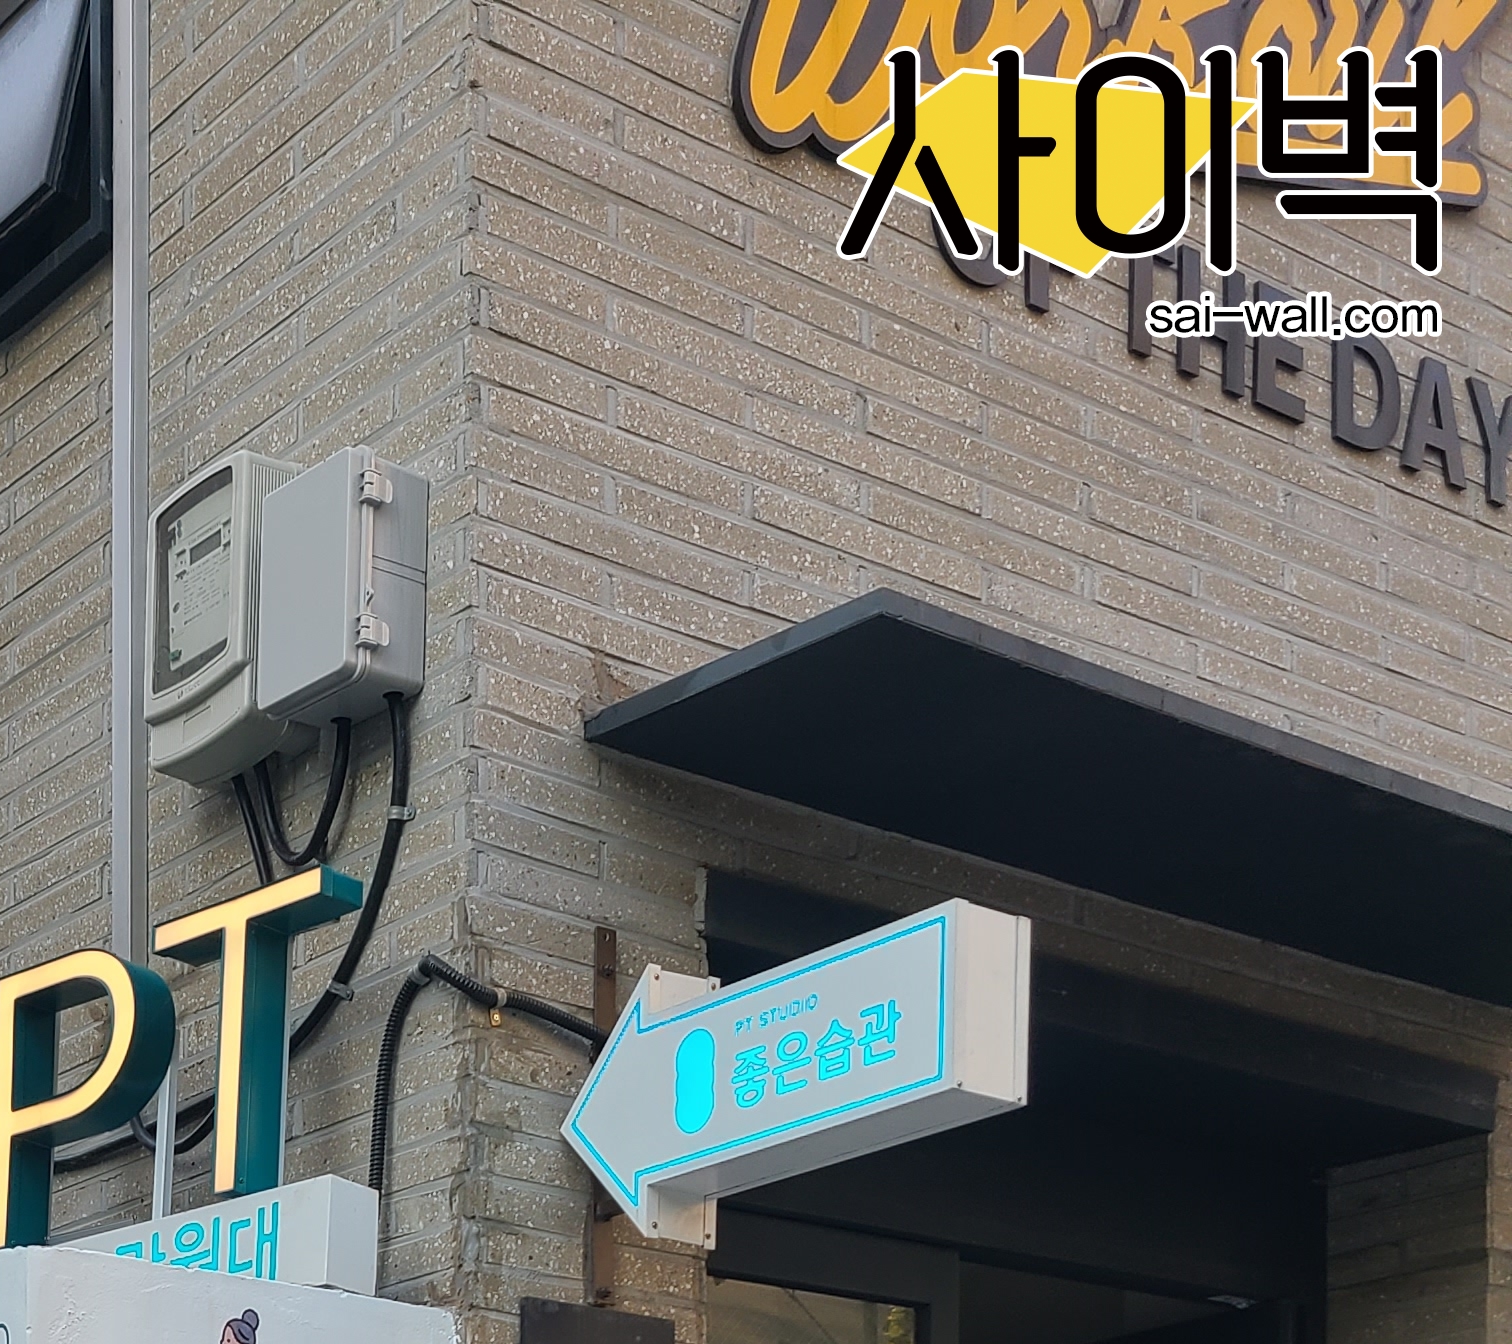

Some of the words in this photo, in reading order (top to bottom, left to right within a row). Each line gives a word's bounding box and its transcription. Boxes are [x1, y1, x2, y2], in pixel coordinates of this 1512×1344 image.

[735, 1014, 754, 1036] PT
[759, 993, 818, 1028] STUDIO
[730, 999, 902, 1109] 좋은습관
